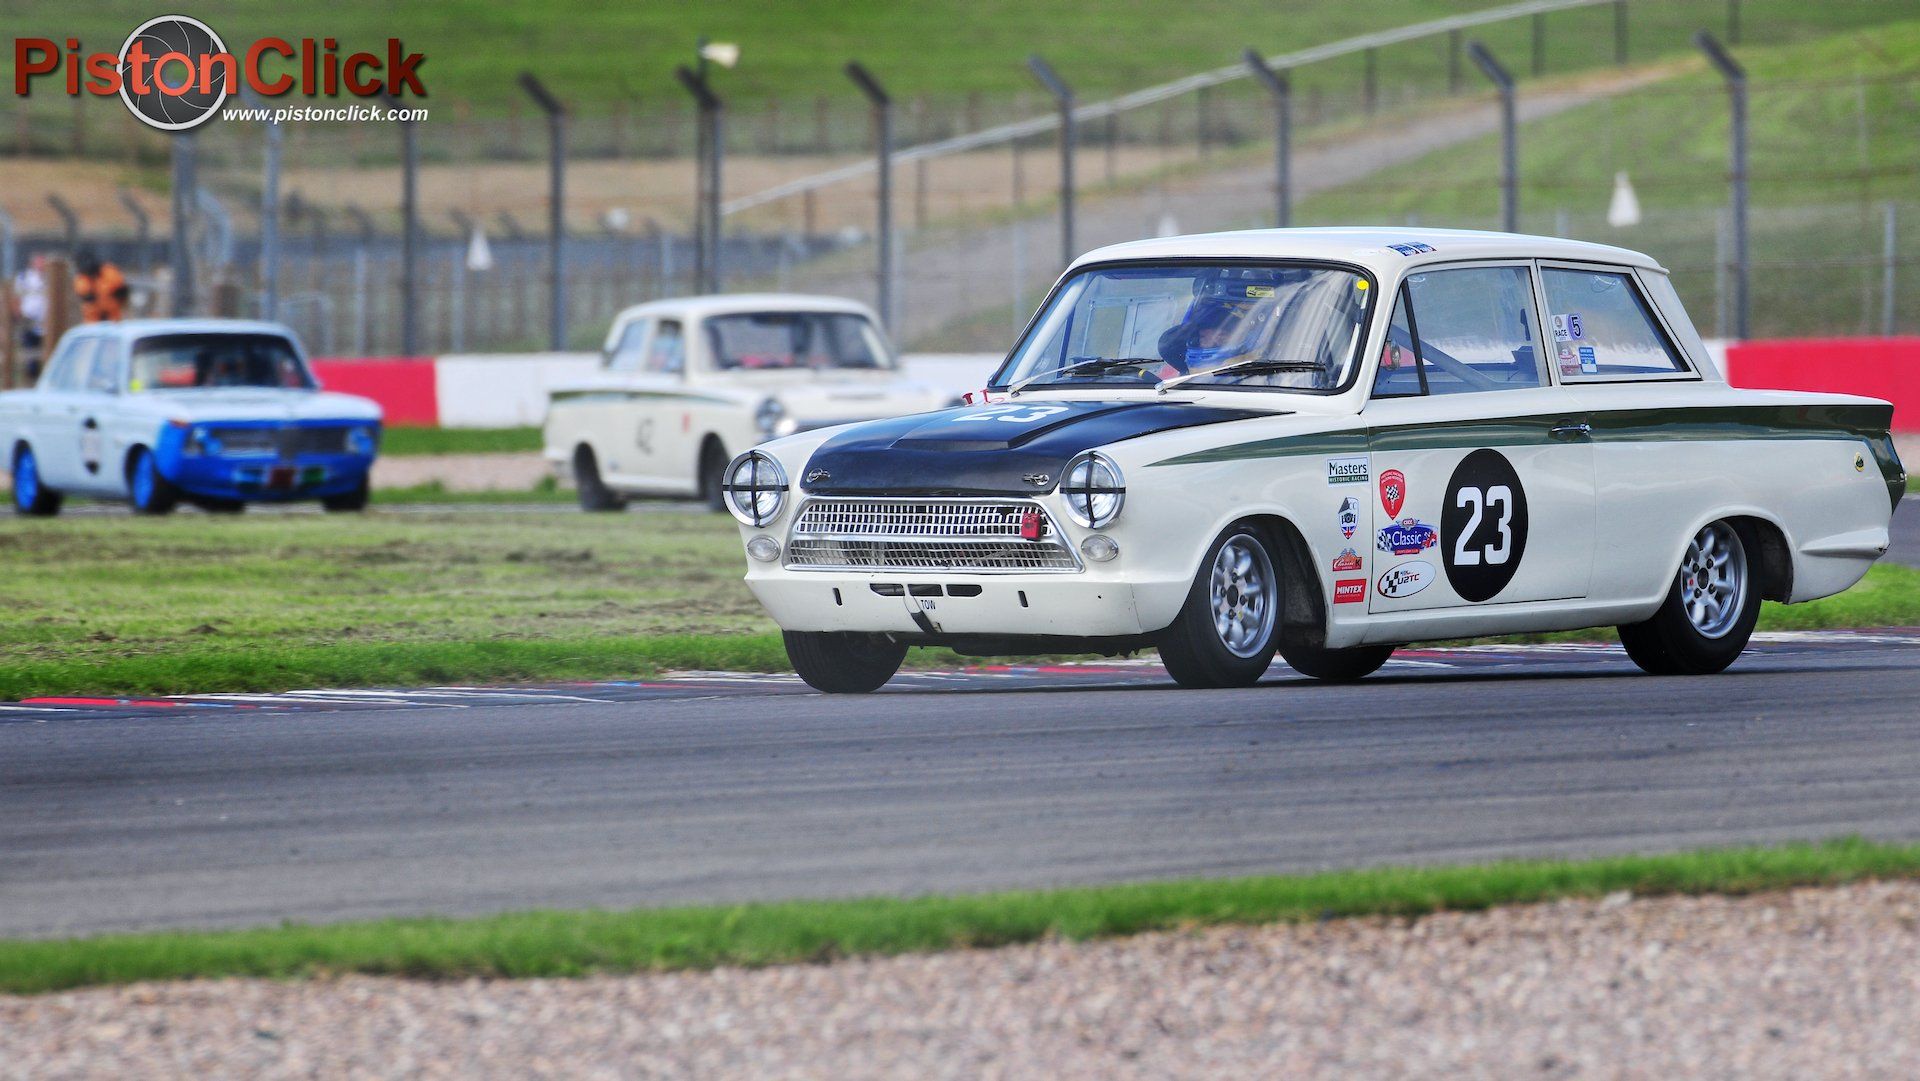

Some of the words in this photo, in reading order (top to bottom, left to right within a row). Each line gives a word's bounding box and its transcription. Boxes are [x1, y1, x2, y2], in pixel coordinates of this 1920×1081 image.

[1555, 329, 1568, 337] RACE
[1571, 316, 1581, 337] 5
[951, 404, 1070, 423] 23
[1328, 462, 1368, 476] Masters
[1329, 475, 1350, 483] HISTORIC
[1453, 484, 1513, 566] 23
[1391, 530, 1422, 546] Classic
[1397, 573, 1420, 585] U2TC
[1336, 585, 1363, 595] MINTEX
[920, 599, 936, 610] TOW
